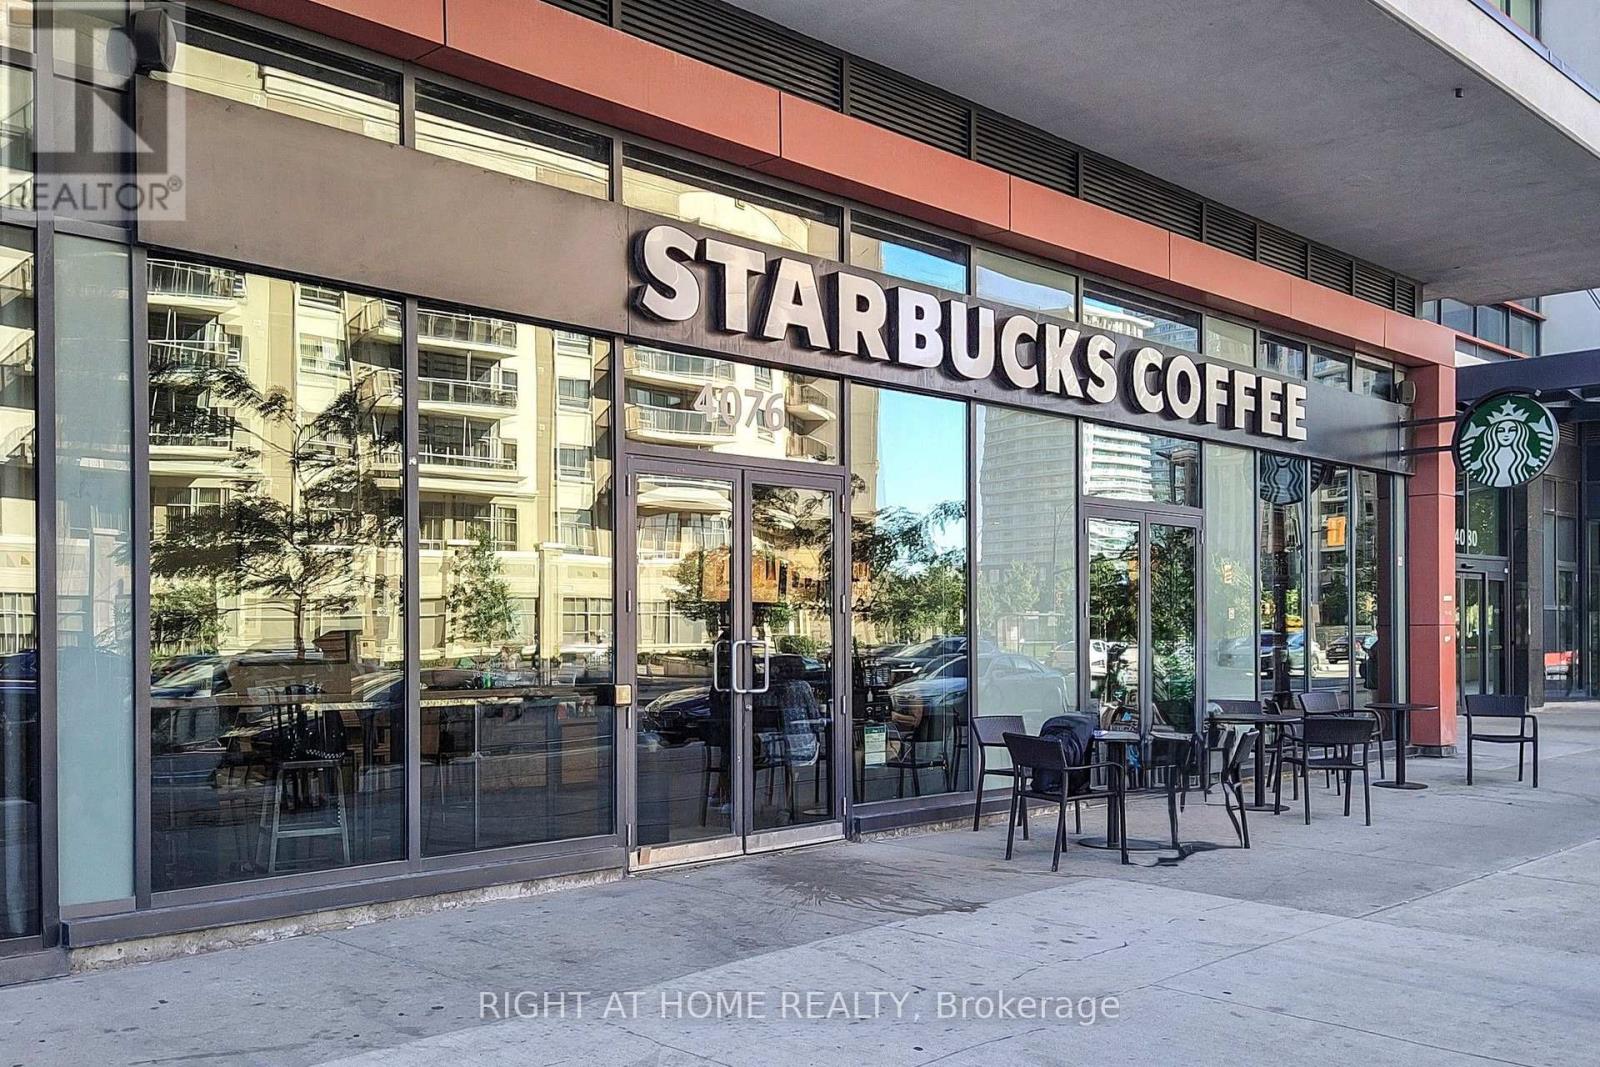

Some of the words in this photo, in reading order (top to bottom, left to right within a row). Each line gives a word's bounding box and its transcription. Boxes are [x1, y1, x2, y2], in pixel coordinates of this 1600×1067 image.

[634, 225, 1117, 405] STARBUCKS
[1131, 347, 1307, 441] COFFEE
[692, 382, 785, 432] 4076
